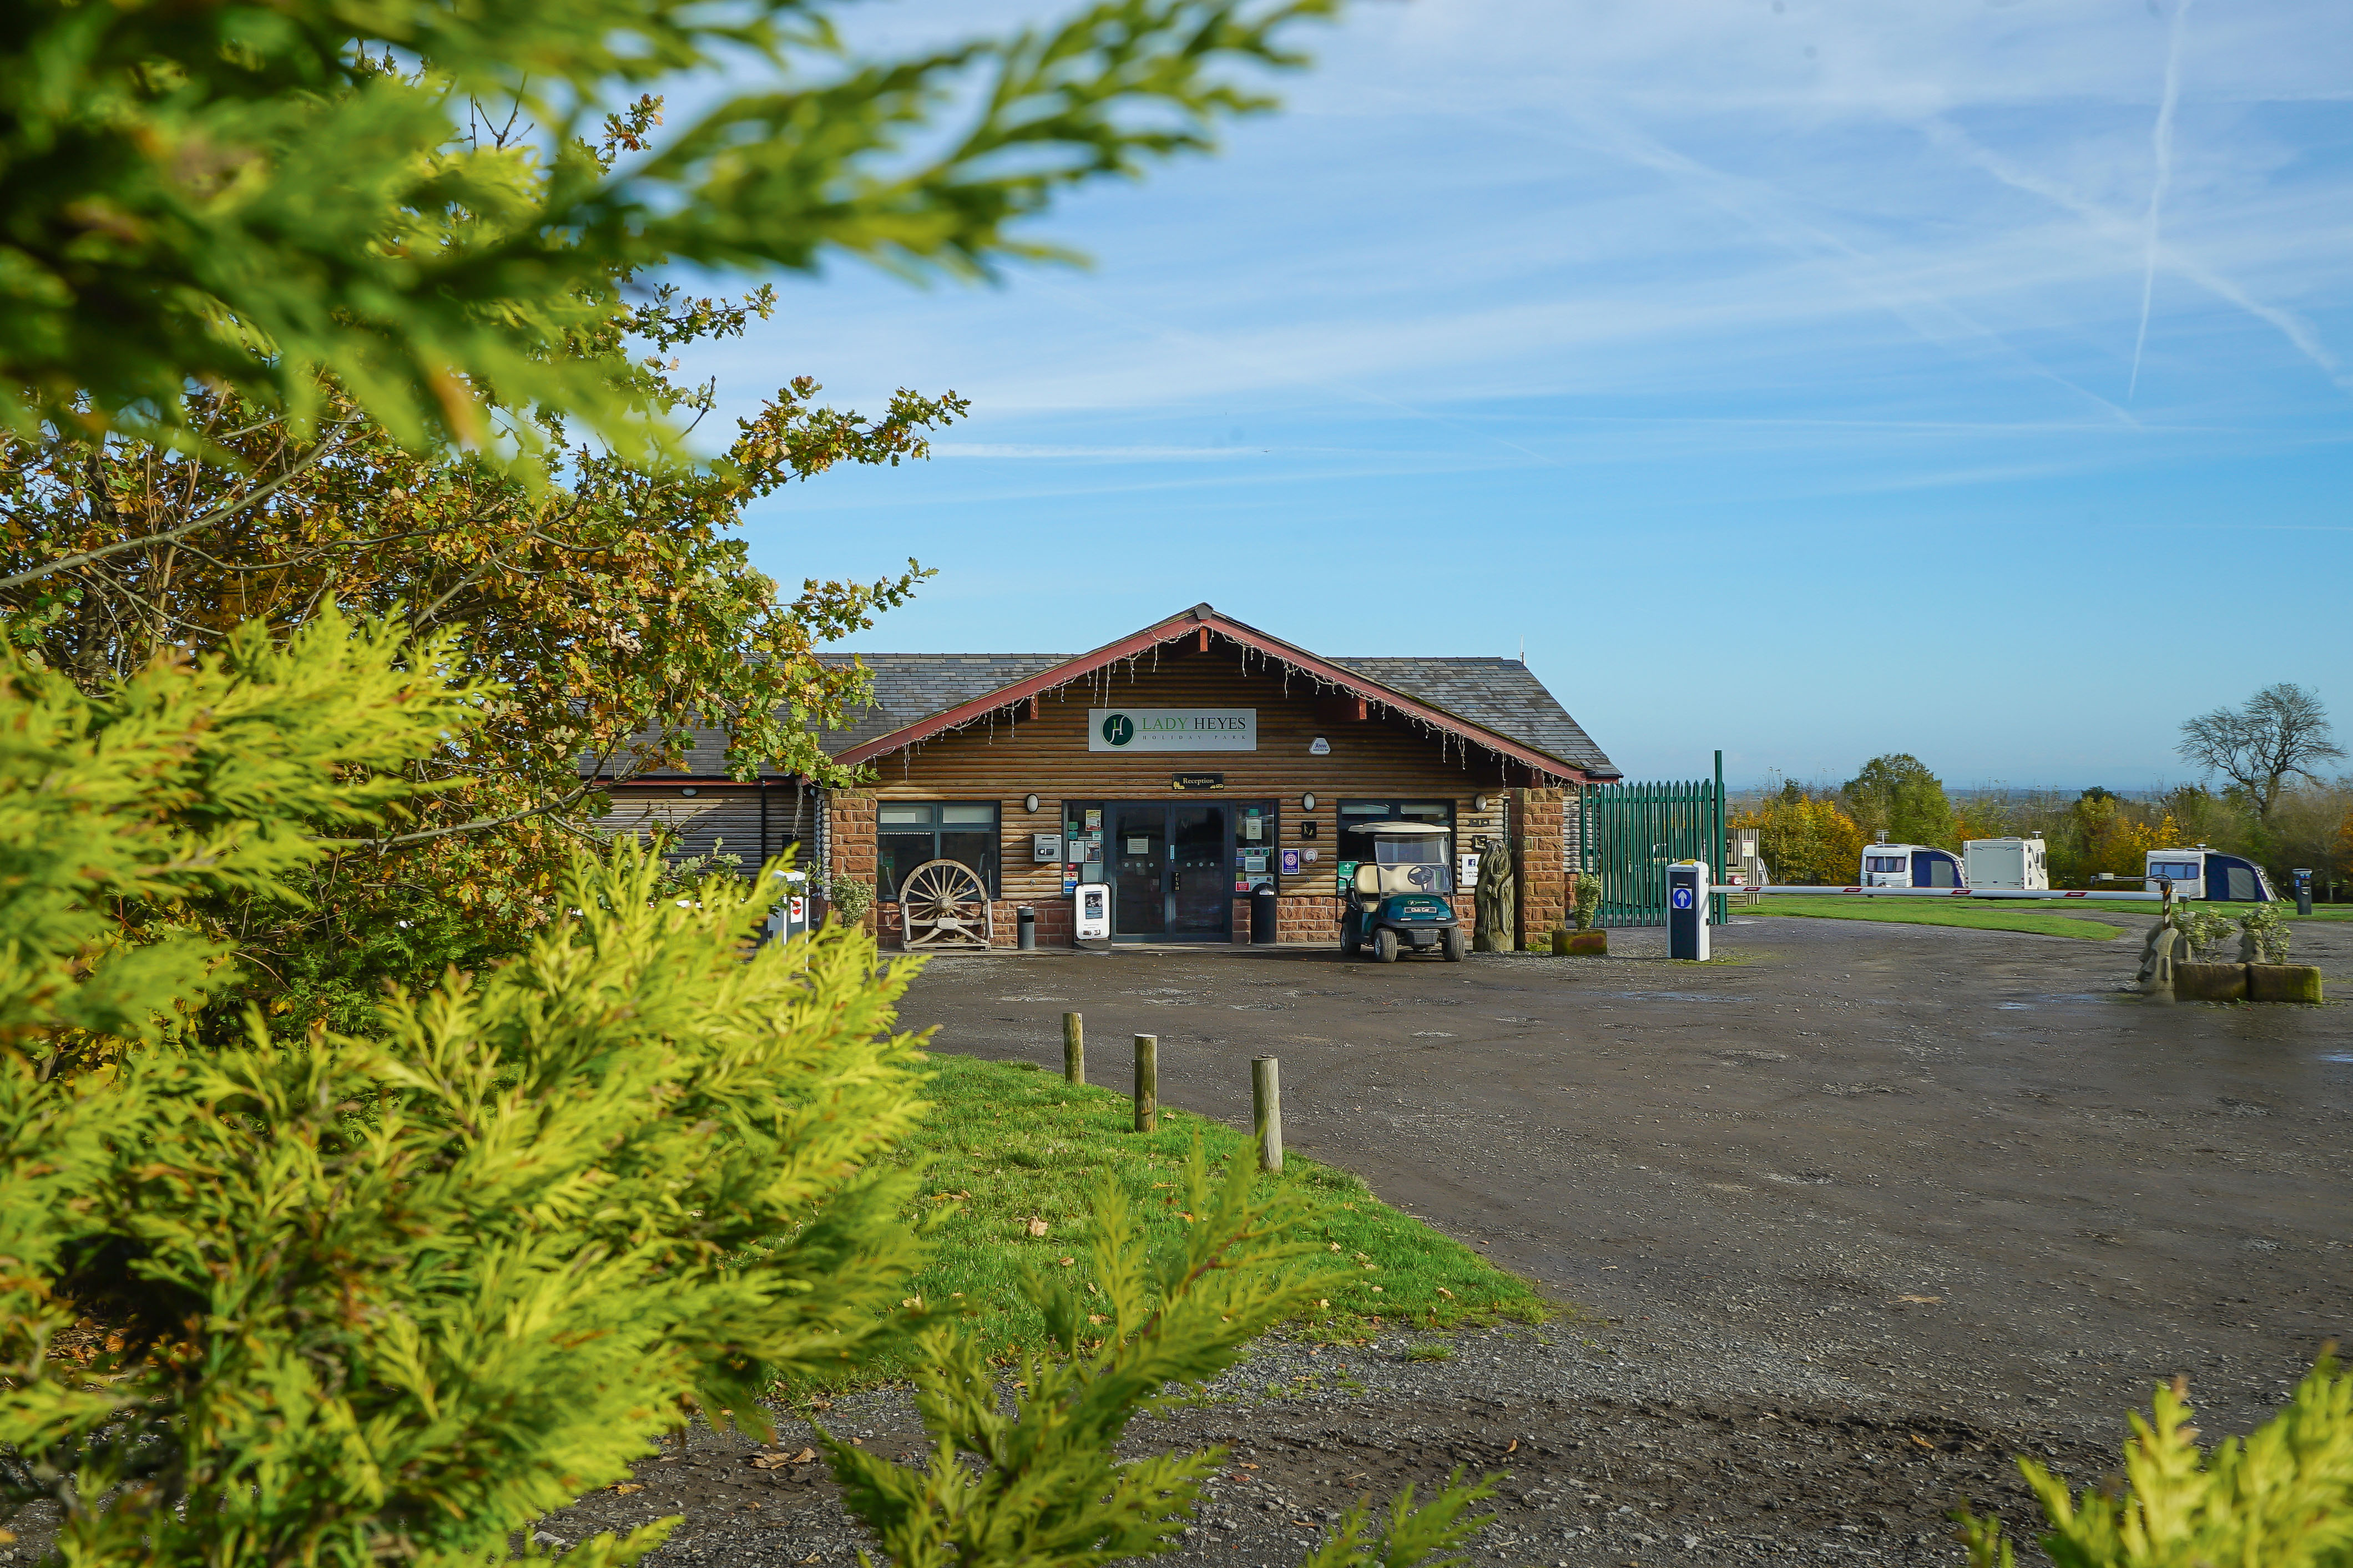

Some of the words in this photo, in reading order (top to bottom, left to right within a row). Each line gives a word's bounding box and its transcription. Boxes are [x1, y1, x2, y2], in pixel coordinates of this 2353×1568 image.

[1142, 717, 1189, 730] LADY
[1194, 717, 1246, 730] HEYES
[1183, 777, 1214, 786] Reception
